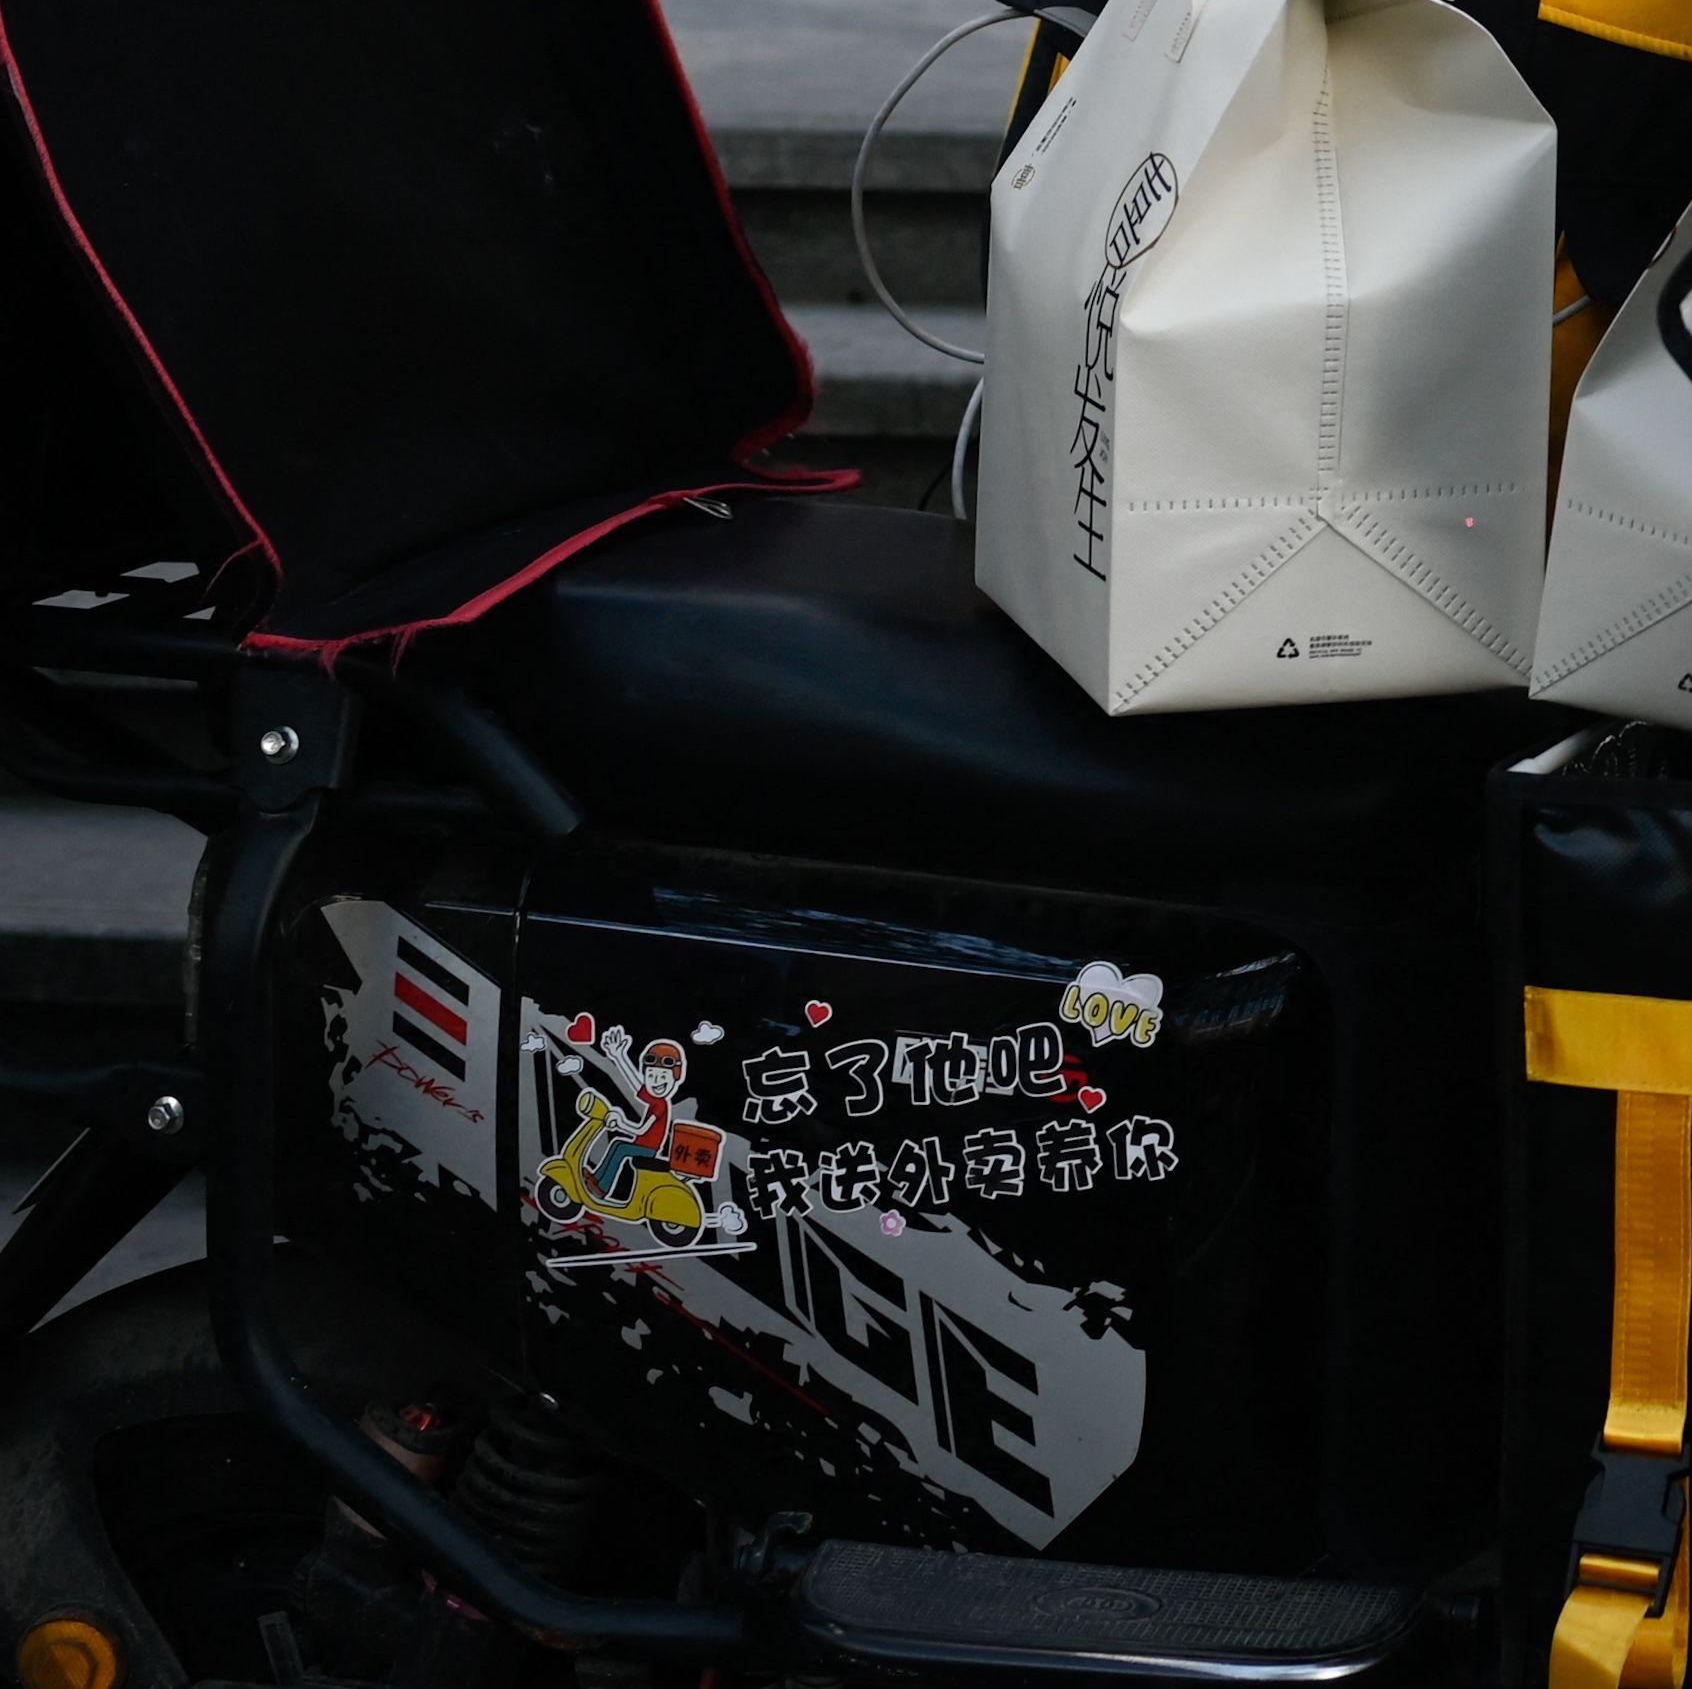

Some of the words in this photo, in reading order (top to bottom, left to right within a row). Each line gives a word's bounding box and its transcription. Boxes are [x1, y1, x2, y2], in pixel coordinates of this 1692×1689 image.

[1061, 983, 1160, 1045] LOVE
[742, 1021, 1070, 1125] 忘了他吧
[675, 1142, 712, 1168] 外卖
[747, 1113, 1180, 1223] 我送外卖养你
